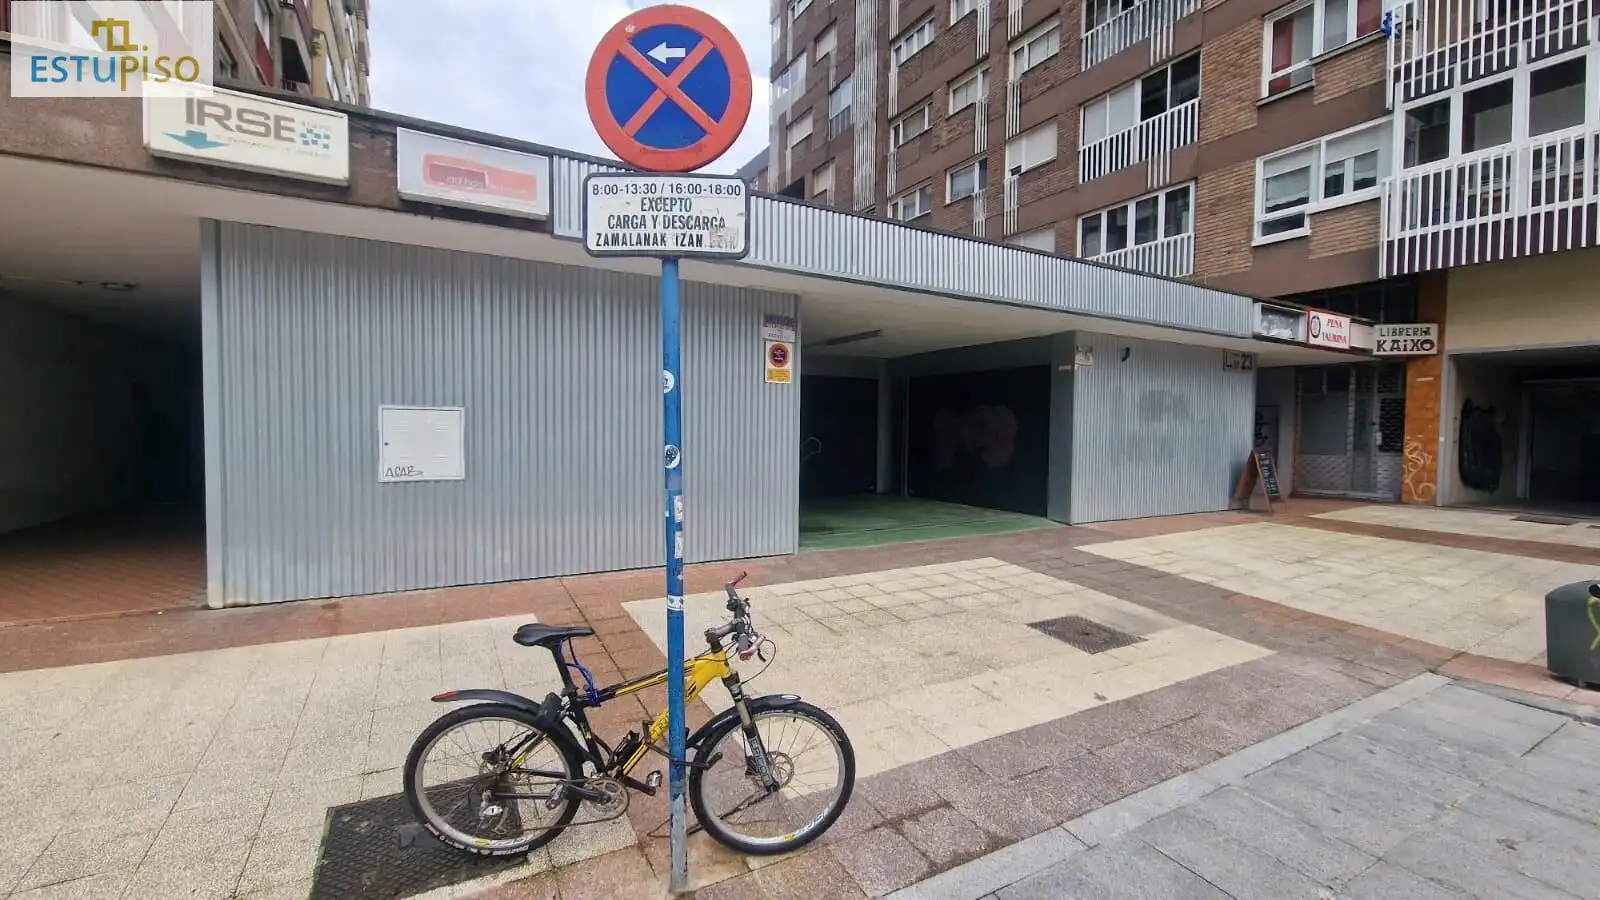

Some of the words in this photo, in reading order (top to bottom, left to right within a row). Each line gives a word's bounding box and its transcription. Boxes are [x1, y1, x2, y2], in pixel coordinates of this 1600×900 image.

[185, 93, 296, 143] IRSE
[592, 183, 657, 195] 8:00-13:30
[669, 183, 741, 196] 16:00-18:00
[640, 197, 692, 212] EXCEPTO
[608, 214, 647, 229] CARGA
[651, 215, 659, 229] Y
[663, 215, 725, 231] DESCARGA
[596, 233, 667, 247] ZAMALANAK
[1241, 352, 1252, 370] 23
